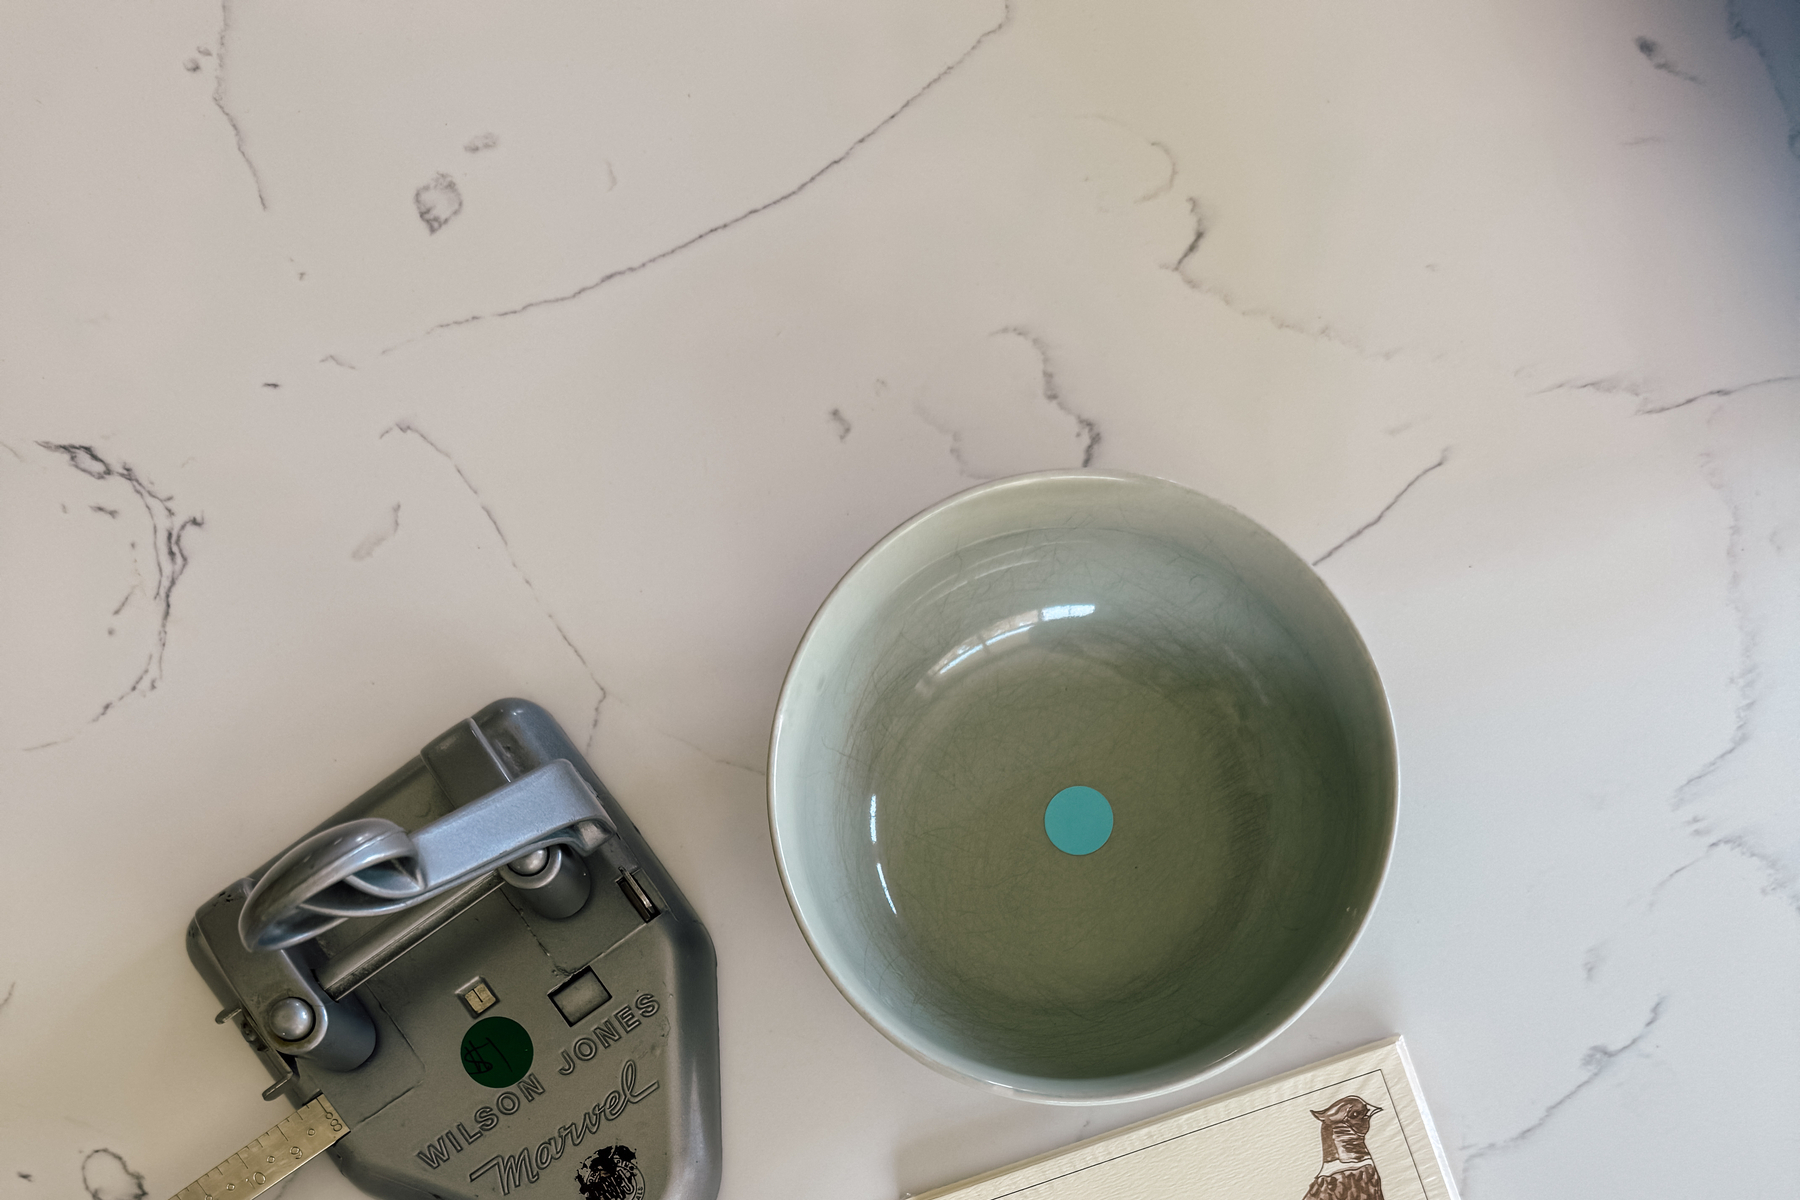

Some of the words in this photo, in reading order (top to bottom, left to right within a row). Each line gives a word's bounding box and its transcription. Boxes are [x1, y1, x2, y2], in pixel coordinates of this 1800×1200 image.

[415, 1072, 546, 1170] WILSON
[557, 993, 661, 1076] JONES
[463, 1036, 513, 1076] $1
[245, 1171, 267, 1190] 10
[329, 1118, 343, 1133] 8
[469, 1059, 660, 1196] Marvel
